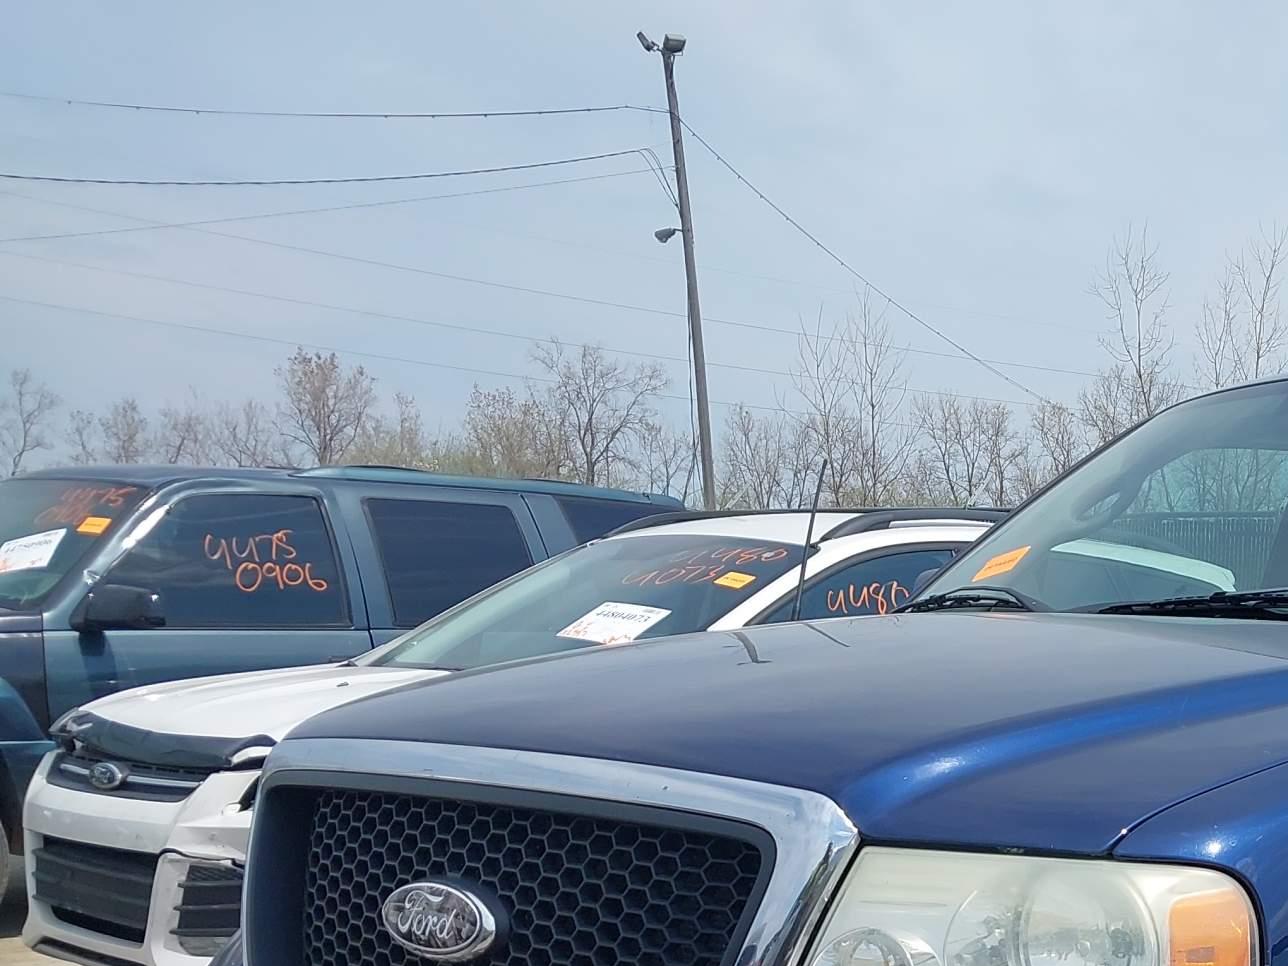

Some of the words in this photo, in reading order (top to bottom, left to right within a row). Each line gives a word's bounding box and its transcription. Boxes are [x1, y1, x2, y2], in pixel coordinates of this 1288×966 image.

[204, 529, 297, 570] 4475
[235, 561, 328, 592] 0906
[397, 889, 455, 940] Ford
